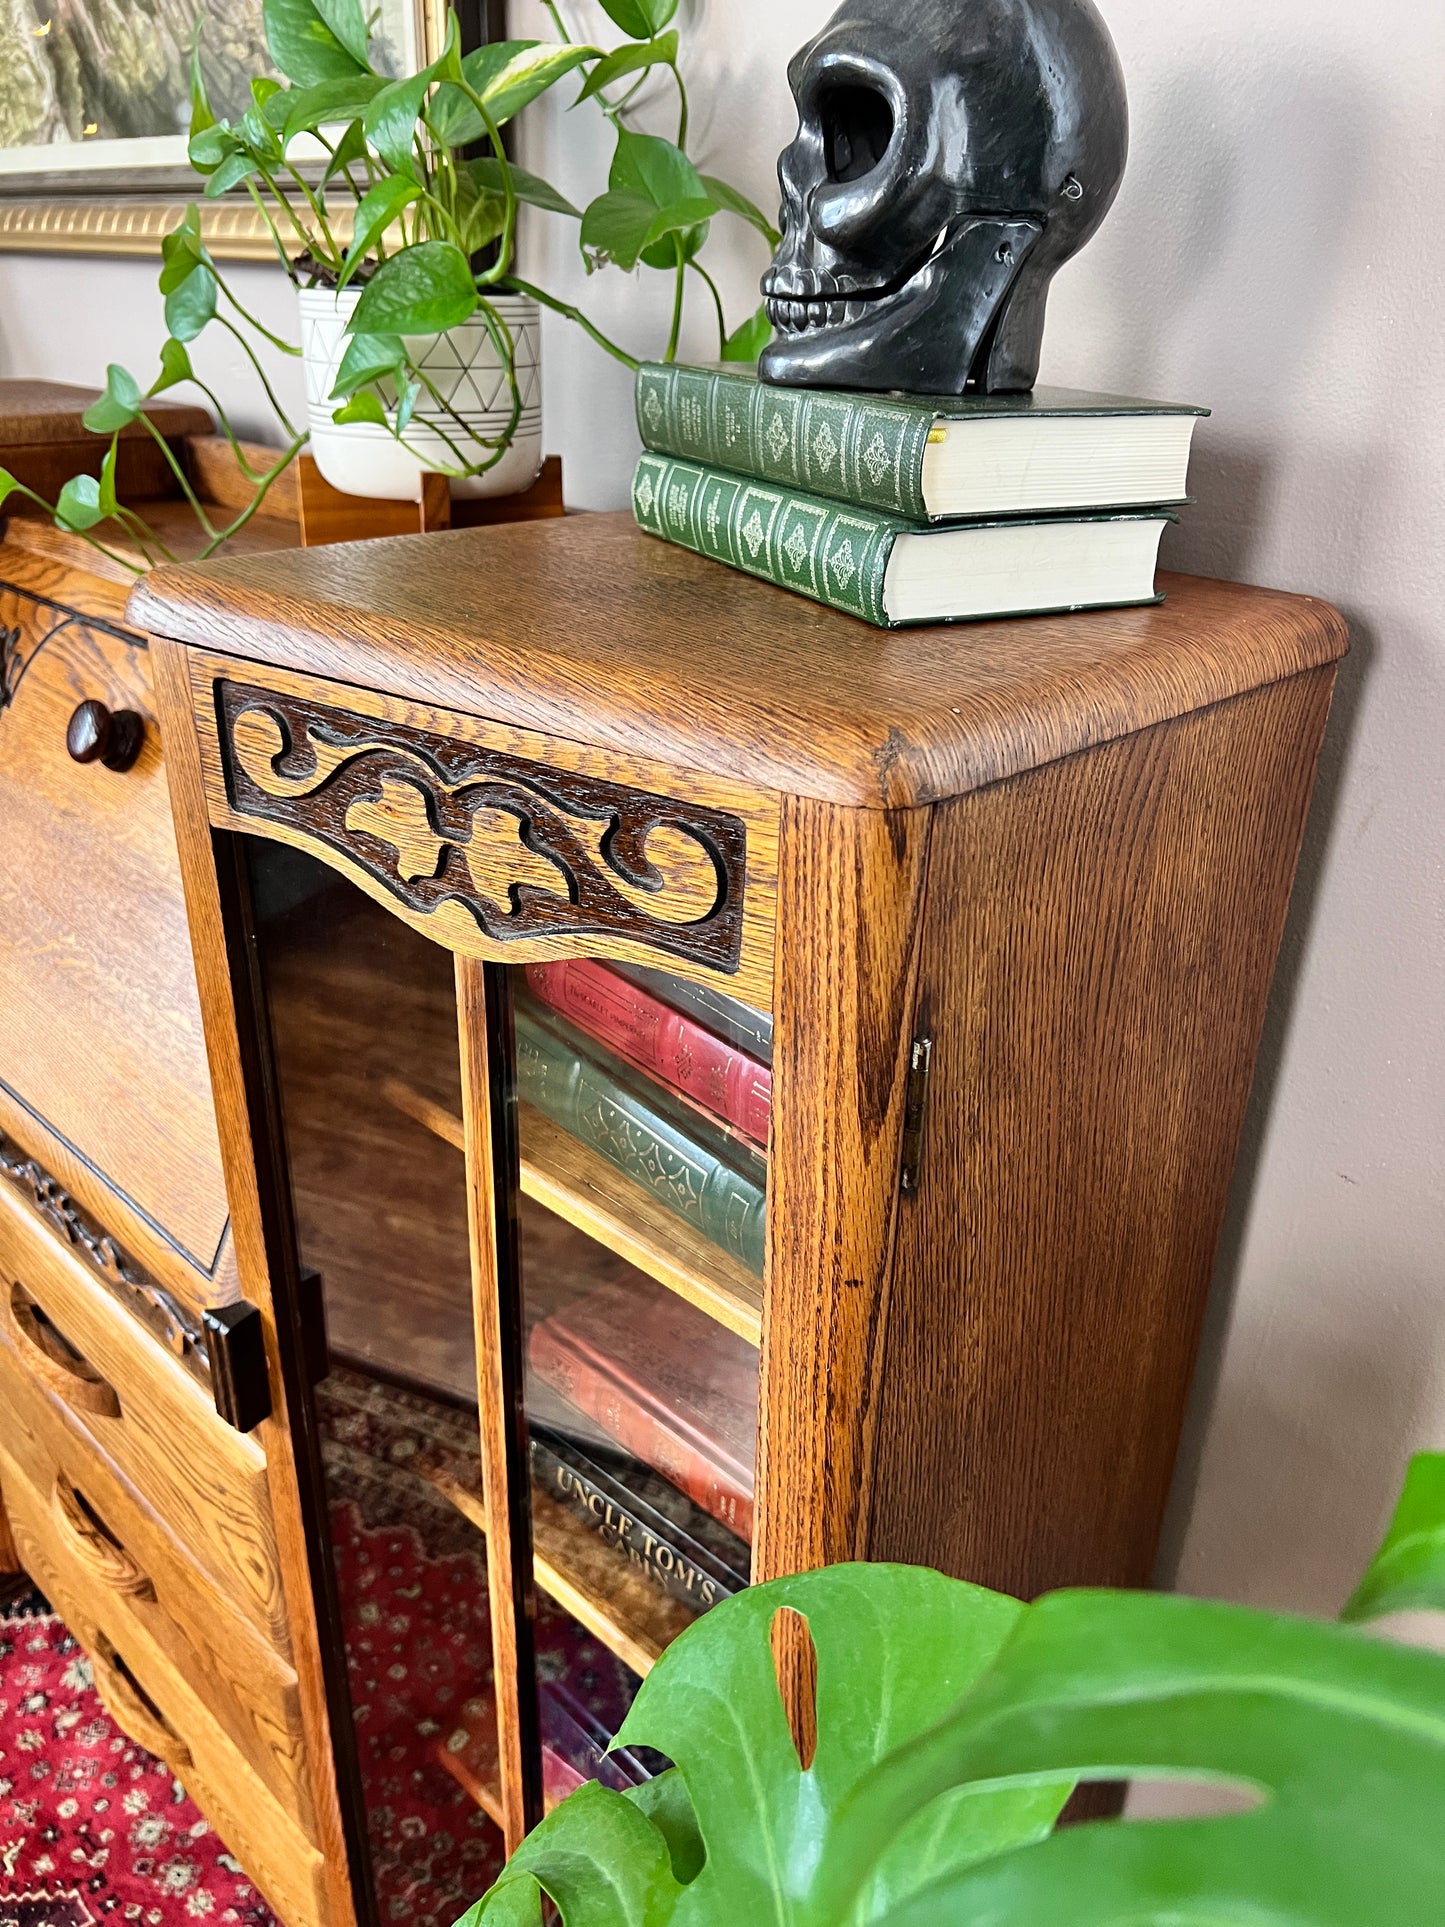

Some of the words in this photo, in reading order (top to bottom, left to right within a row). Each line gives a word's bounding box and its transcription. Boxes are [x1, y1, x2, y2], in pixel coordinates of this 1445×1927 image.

[911, 416, 926, 455] EDITION
[557, 1466, 632, 1542] UNCLE
[641, 1530, 716, 1605] TOM'S
[598, 1524, 669, 1591] CABIN
